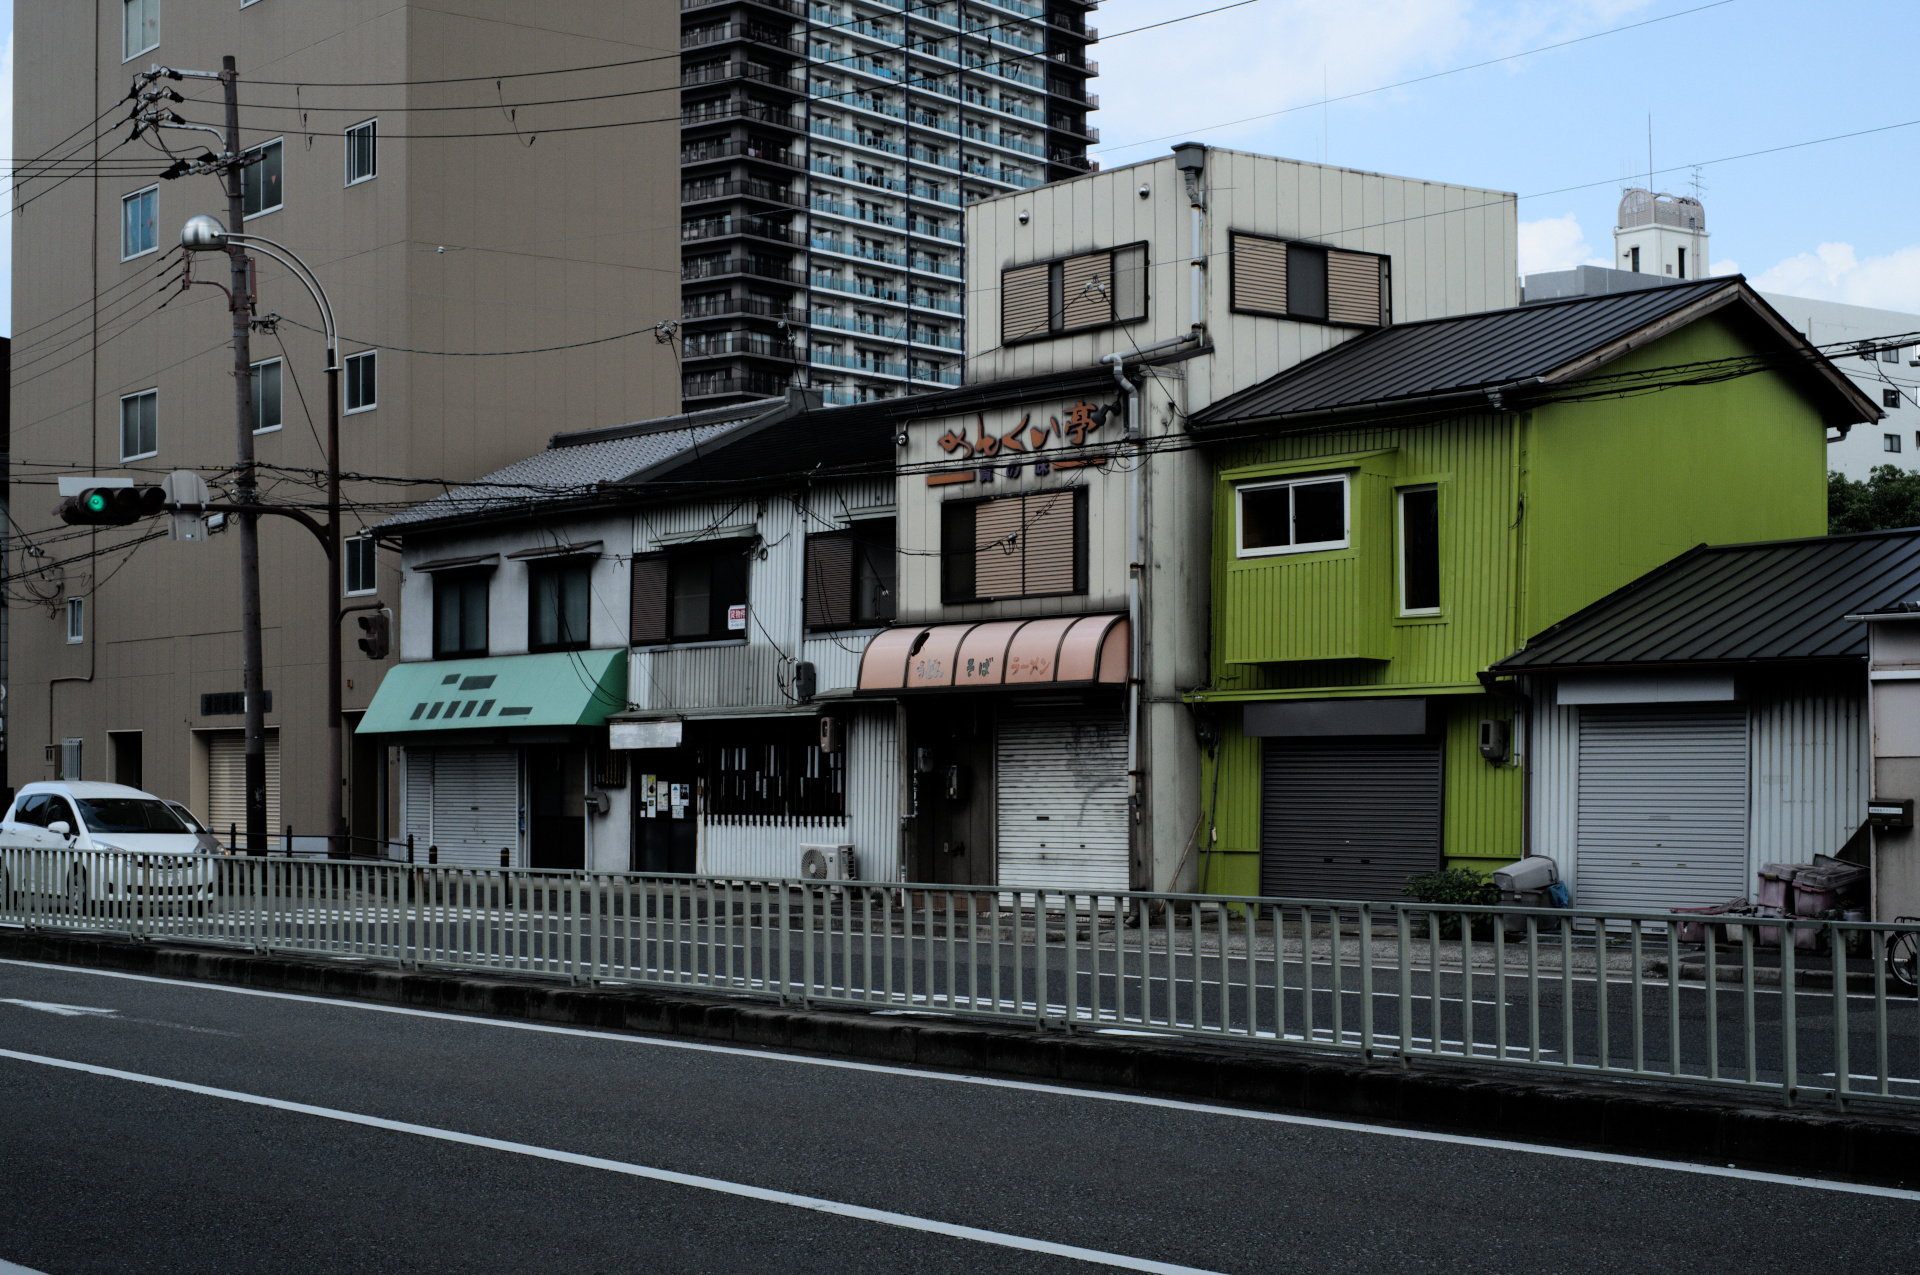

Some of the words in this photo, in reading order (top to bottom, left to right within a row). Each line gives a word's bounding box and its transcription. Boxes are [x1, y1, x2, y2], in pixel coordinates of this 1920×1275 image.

[938, 401, 1099, 459] めんくい亭
[917, 658, 944, 679] うどん
[966, 657, 994, 677] そば
[1010, 656, 1051, 676] ラーメン
